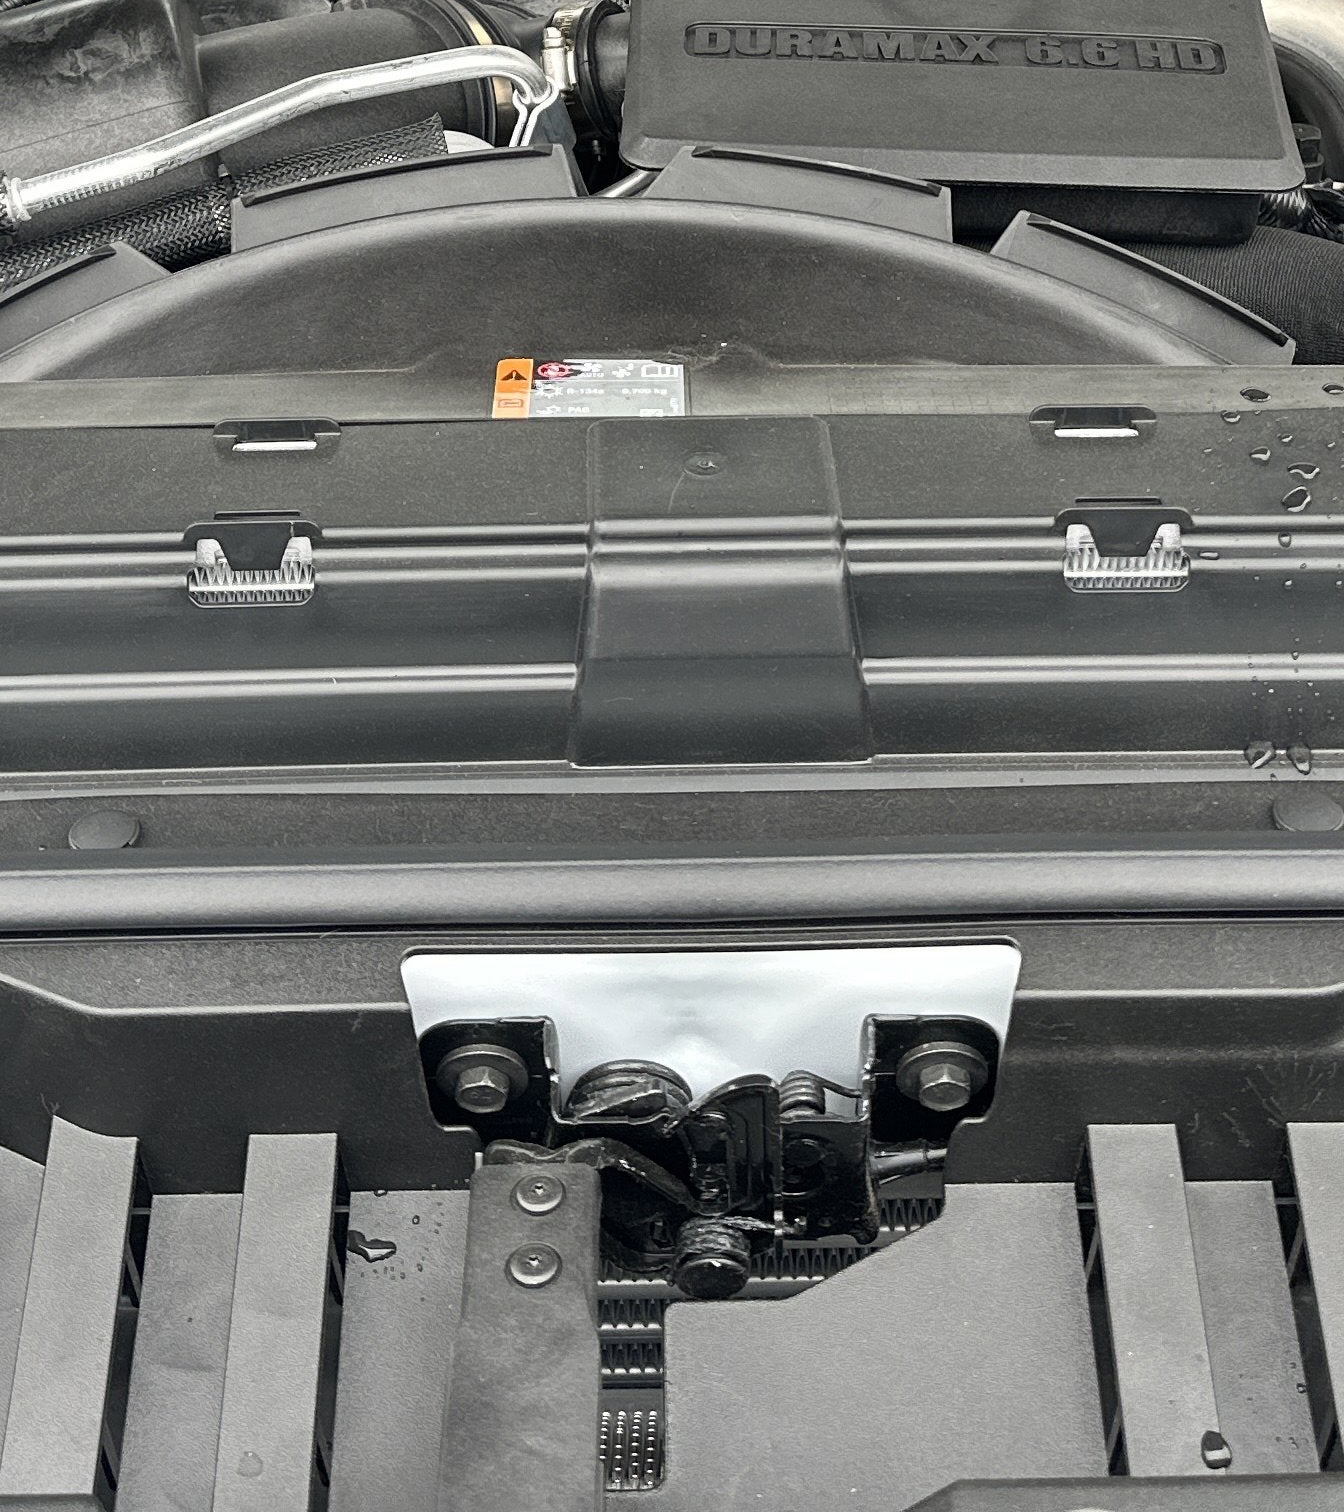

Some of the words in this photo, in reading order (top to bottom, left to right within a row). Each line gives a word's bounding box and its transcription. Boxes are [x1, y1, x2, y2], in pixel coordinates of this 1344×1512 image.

[693, 27, 999, 64] DURAMAX
[1025, 37, 1120, 67] 6.6
[1135, 39, 1216, 71] HD
